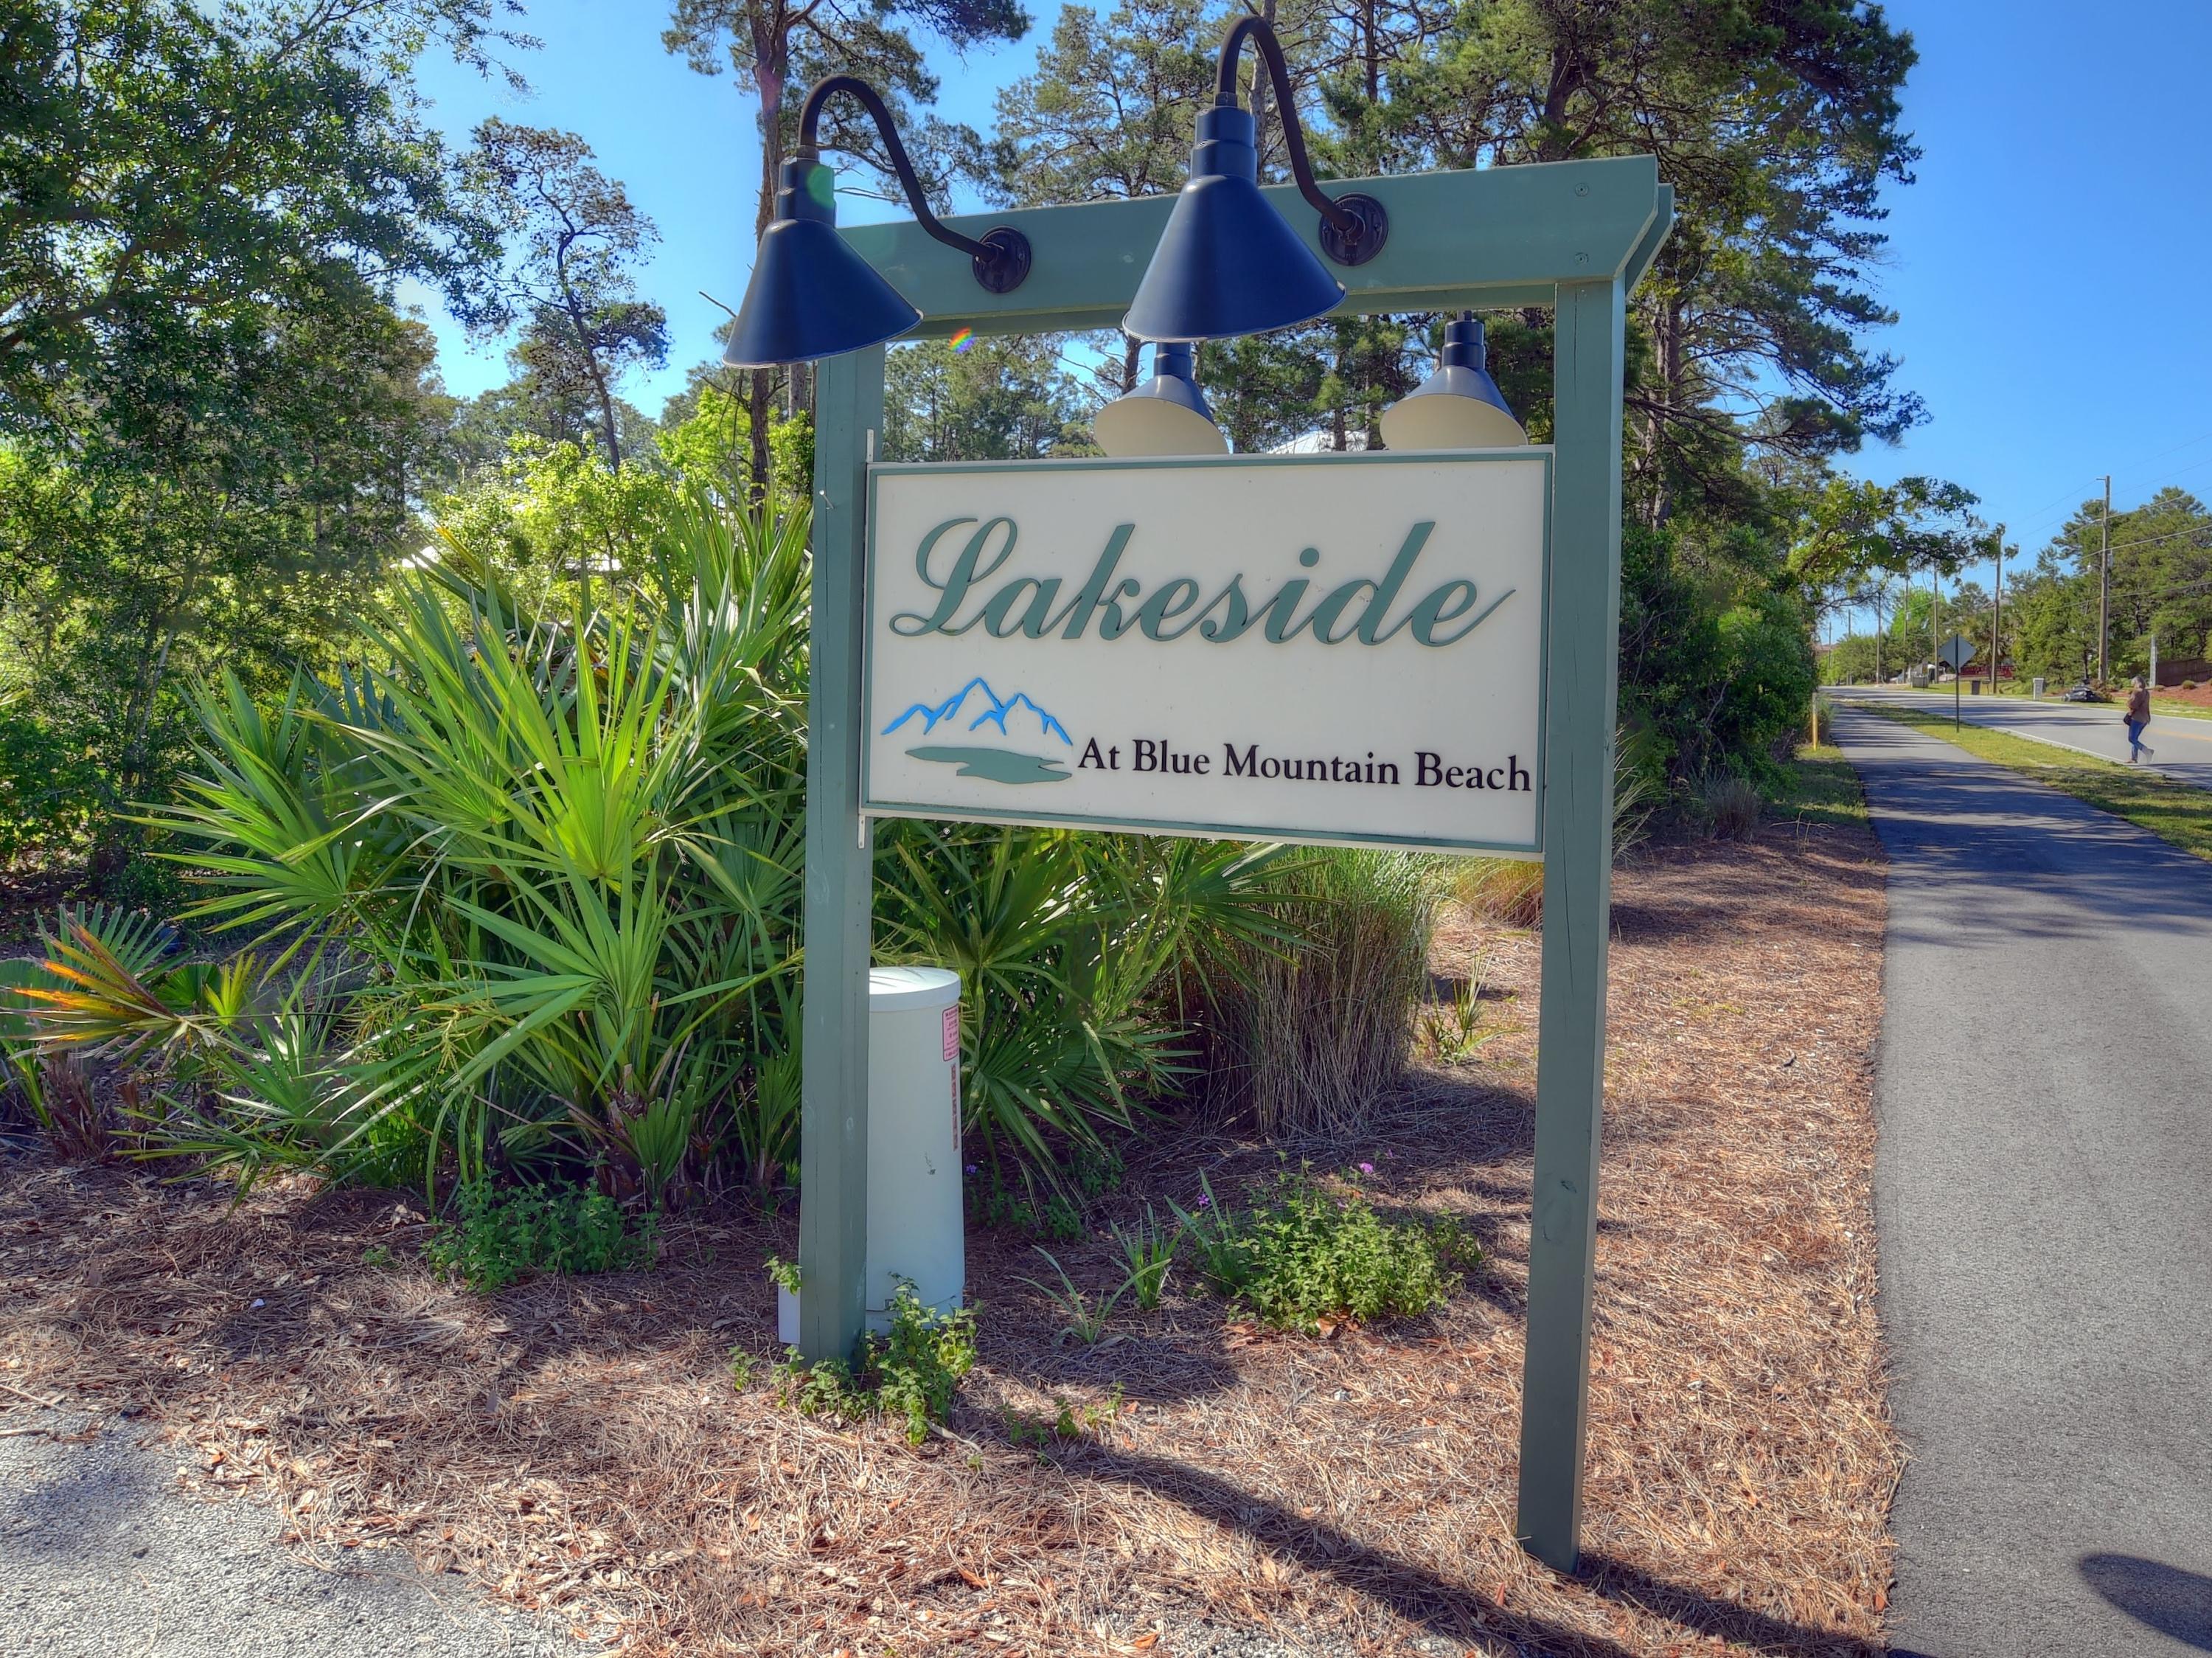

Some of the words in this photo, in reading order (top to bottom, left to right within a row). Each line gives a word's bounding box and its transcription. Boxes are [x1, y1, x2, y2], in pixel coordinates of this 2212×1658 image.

[888, 517, 1514, 648] Lakeside
[1078, 737, 1121, 771] At
[1133, 739, 1210, 775] Blue
[1223, 743, 1400, 785] Mountain
[1414, 752, 1532, 792] Beach
